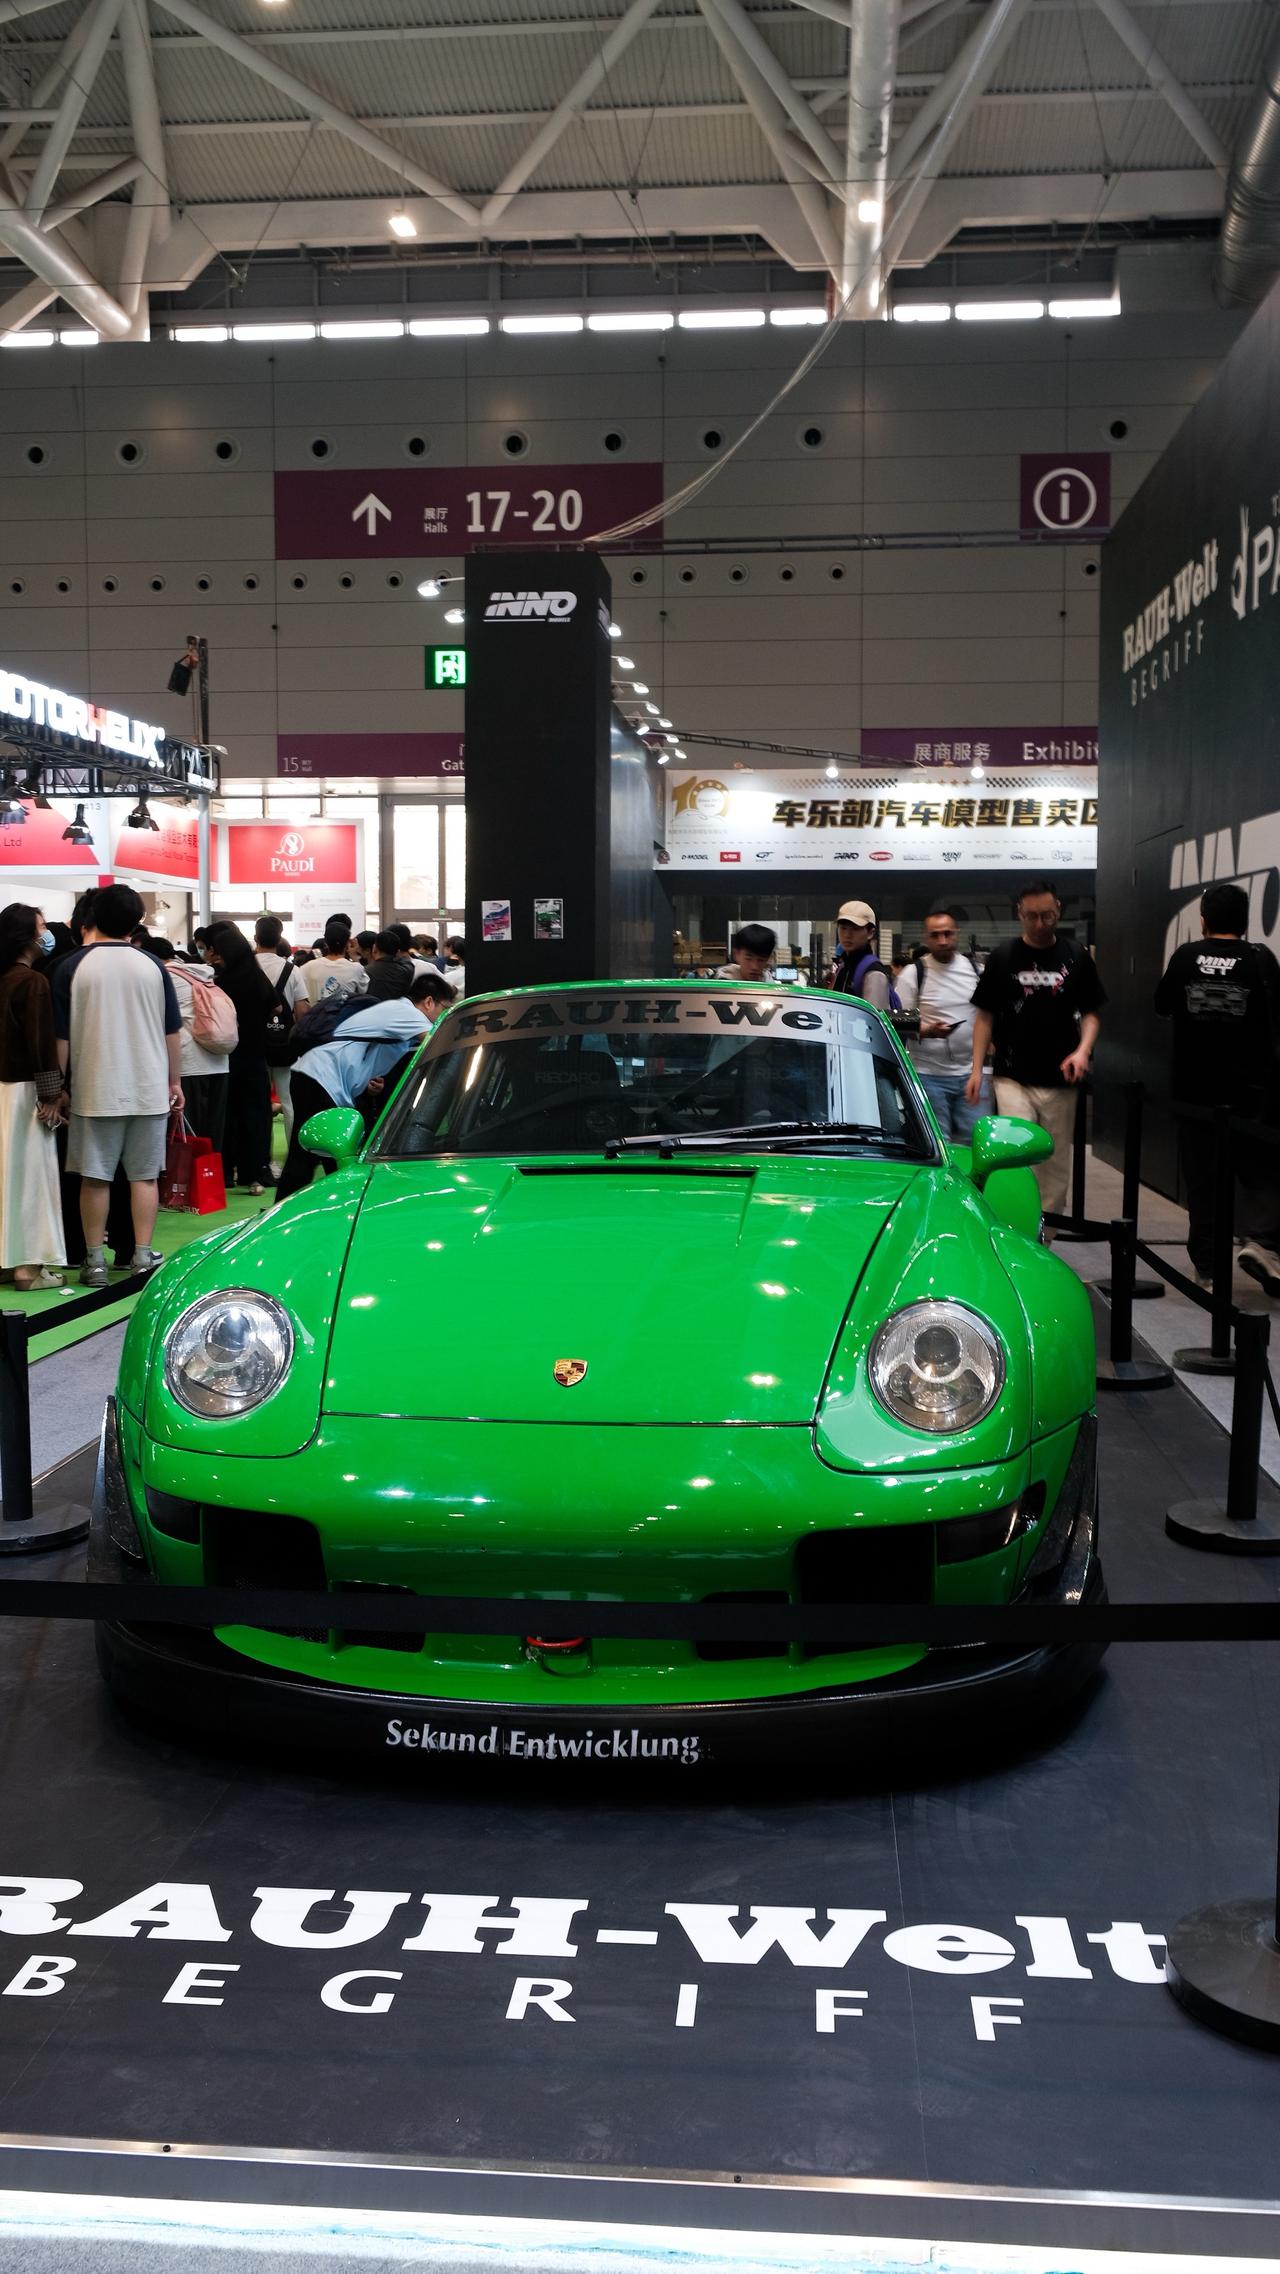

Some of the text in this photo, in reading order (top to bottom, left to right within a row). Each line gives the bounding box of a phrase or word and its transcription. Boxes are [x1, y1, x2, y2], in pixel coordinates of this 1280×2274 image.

[424, 507, 448, 520] 展厅
[466, 489, 583, 532] 17-20
[424, 522, 448, 533] Halls
[485, 591, 578, 616] INNO
[1123, 537, 1219, 673] RAUH-Welt
[1131, 619, 1204, 706] BEGRIFF
[914, 742, 991, 762] 展商服务
[283, 757, 299, 772] 15
[271, 858, 315, 872] PAUDI
[1196, 955, 1237, 967] MINI
[1200, 966, 1226, 975] GT
[386, 1719, 700, 1764] Sekund Entwicklung
[0, 1875, 1168, 1985] RAUH-Welt
[2, 1954, 1025, 2042] BEGRIFF
